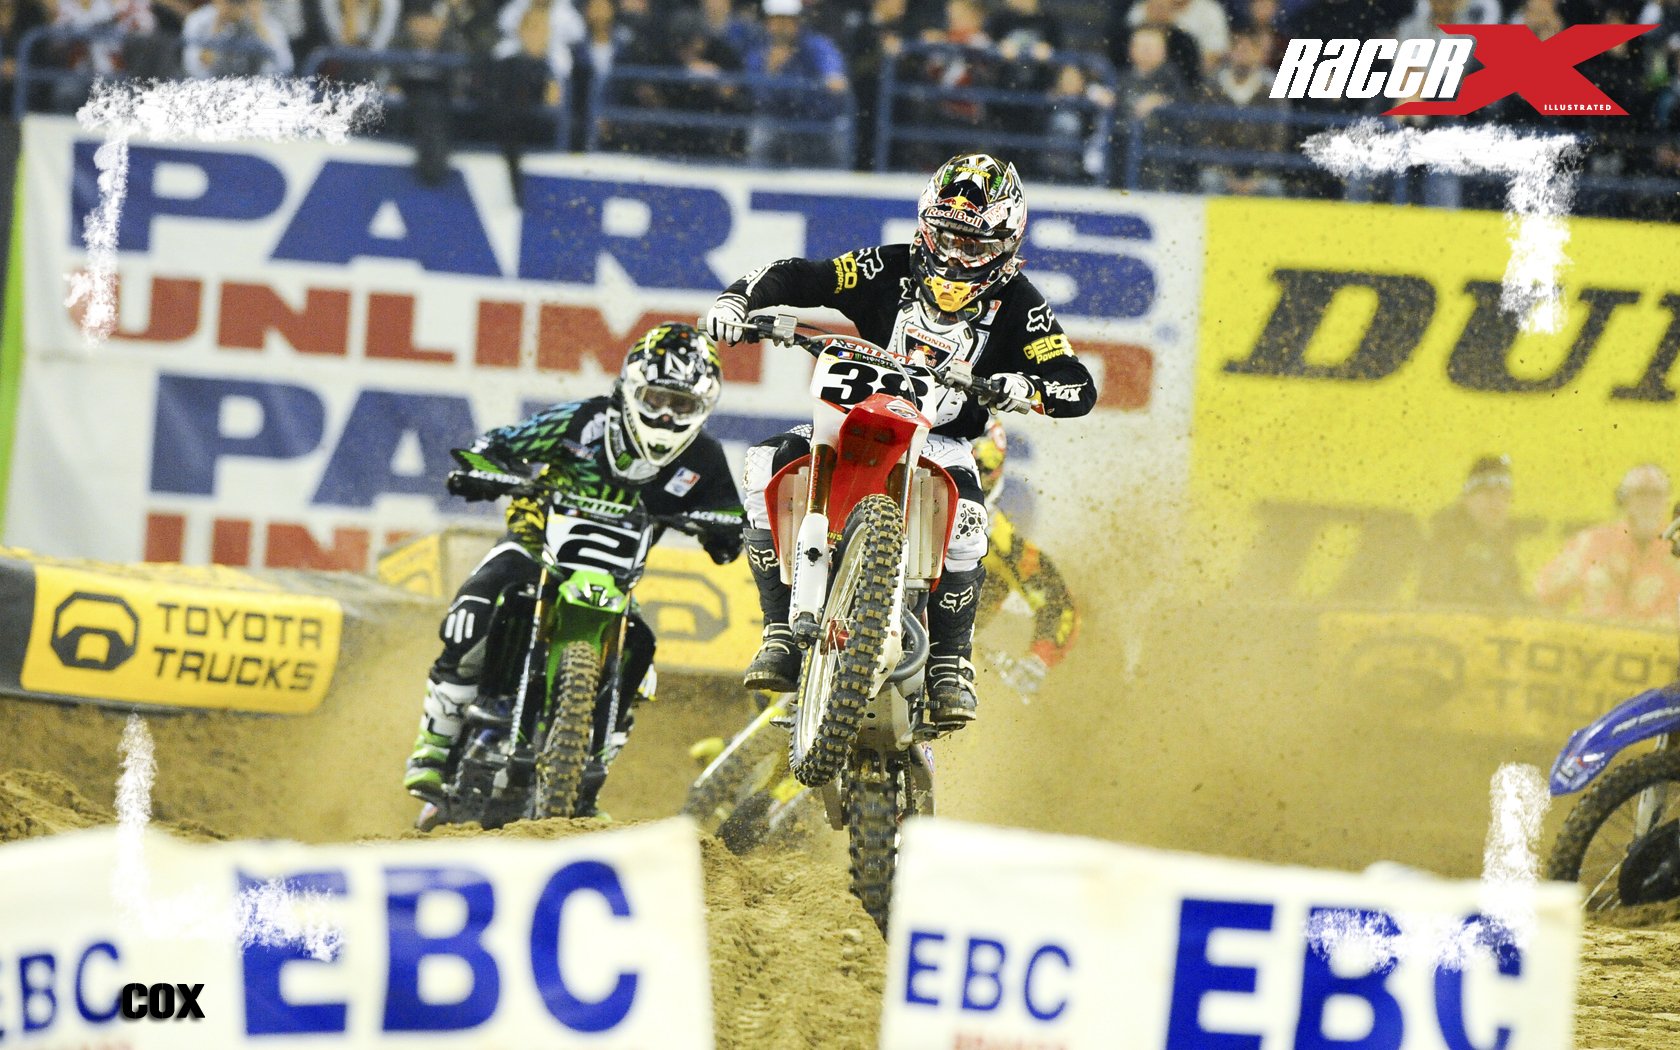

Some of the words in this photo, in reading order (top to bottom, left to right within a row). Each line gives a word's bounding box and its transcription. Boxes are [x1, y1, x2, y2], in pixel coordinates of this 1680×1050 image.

[72, 141, 1157, 318] PARTS
[924, 207, 955, 218] Red
[954, 210, 984, 228] Bull
[66, 274, 1153, 411] UNLIMID
[917, 331, 952, 351] HONDA
[821, 361, 928, 406] 38
[557, 524, 642, 577] 2
[155, 601, 323, 651] TOYOTA
[152, 646, 315, 692] TRUCKS
[236, 859, 640, 1036] EBC
[905, 931, 1071, 1021] EBC
[1163, 896, 1522, 1050] EBC
[0, 942, 123, 1034] BC
